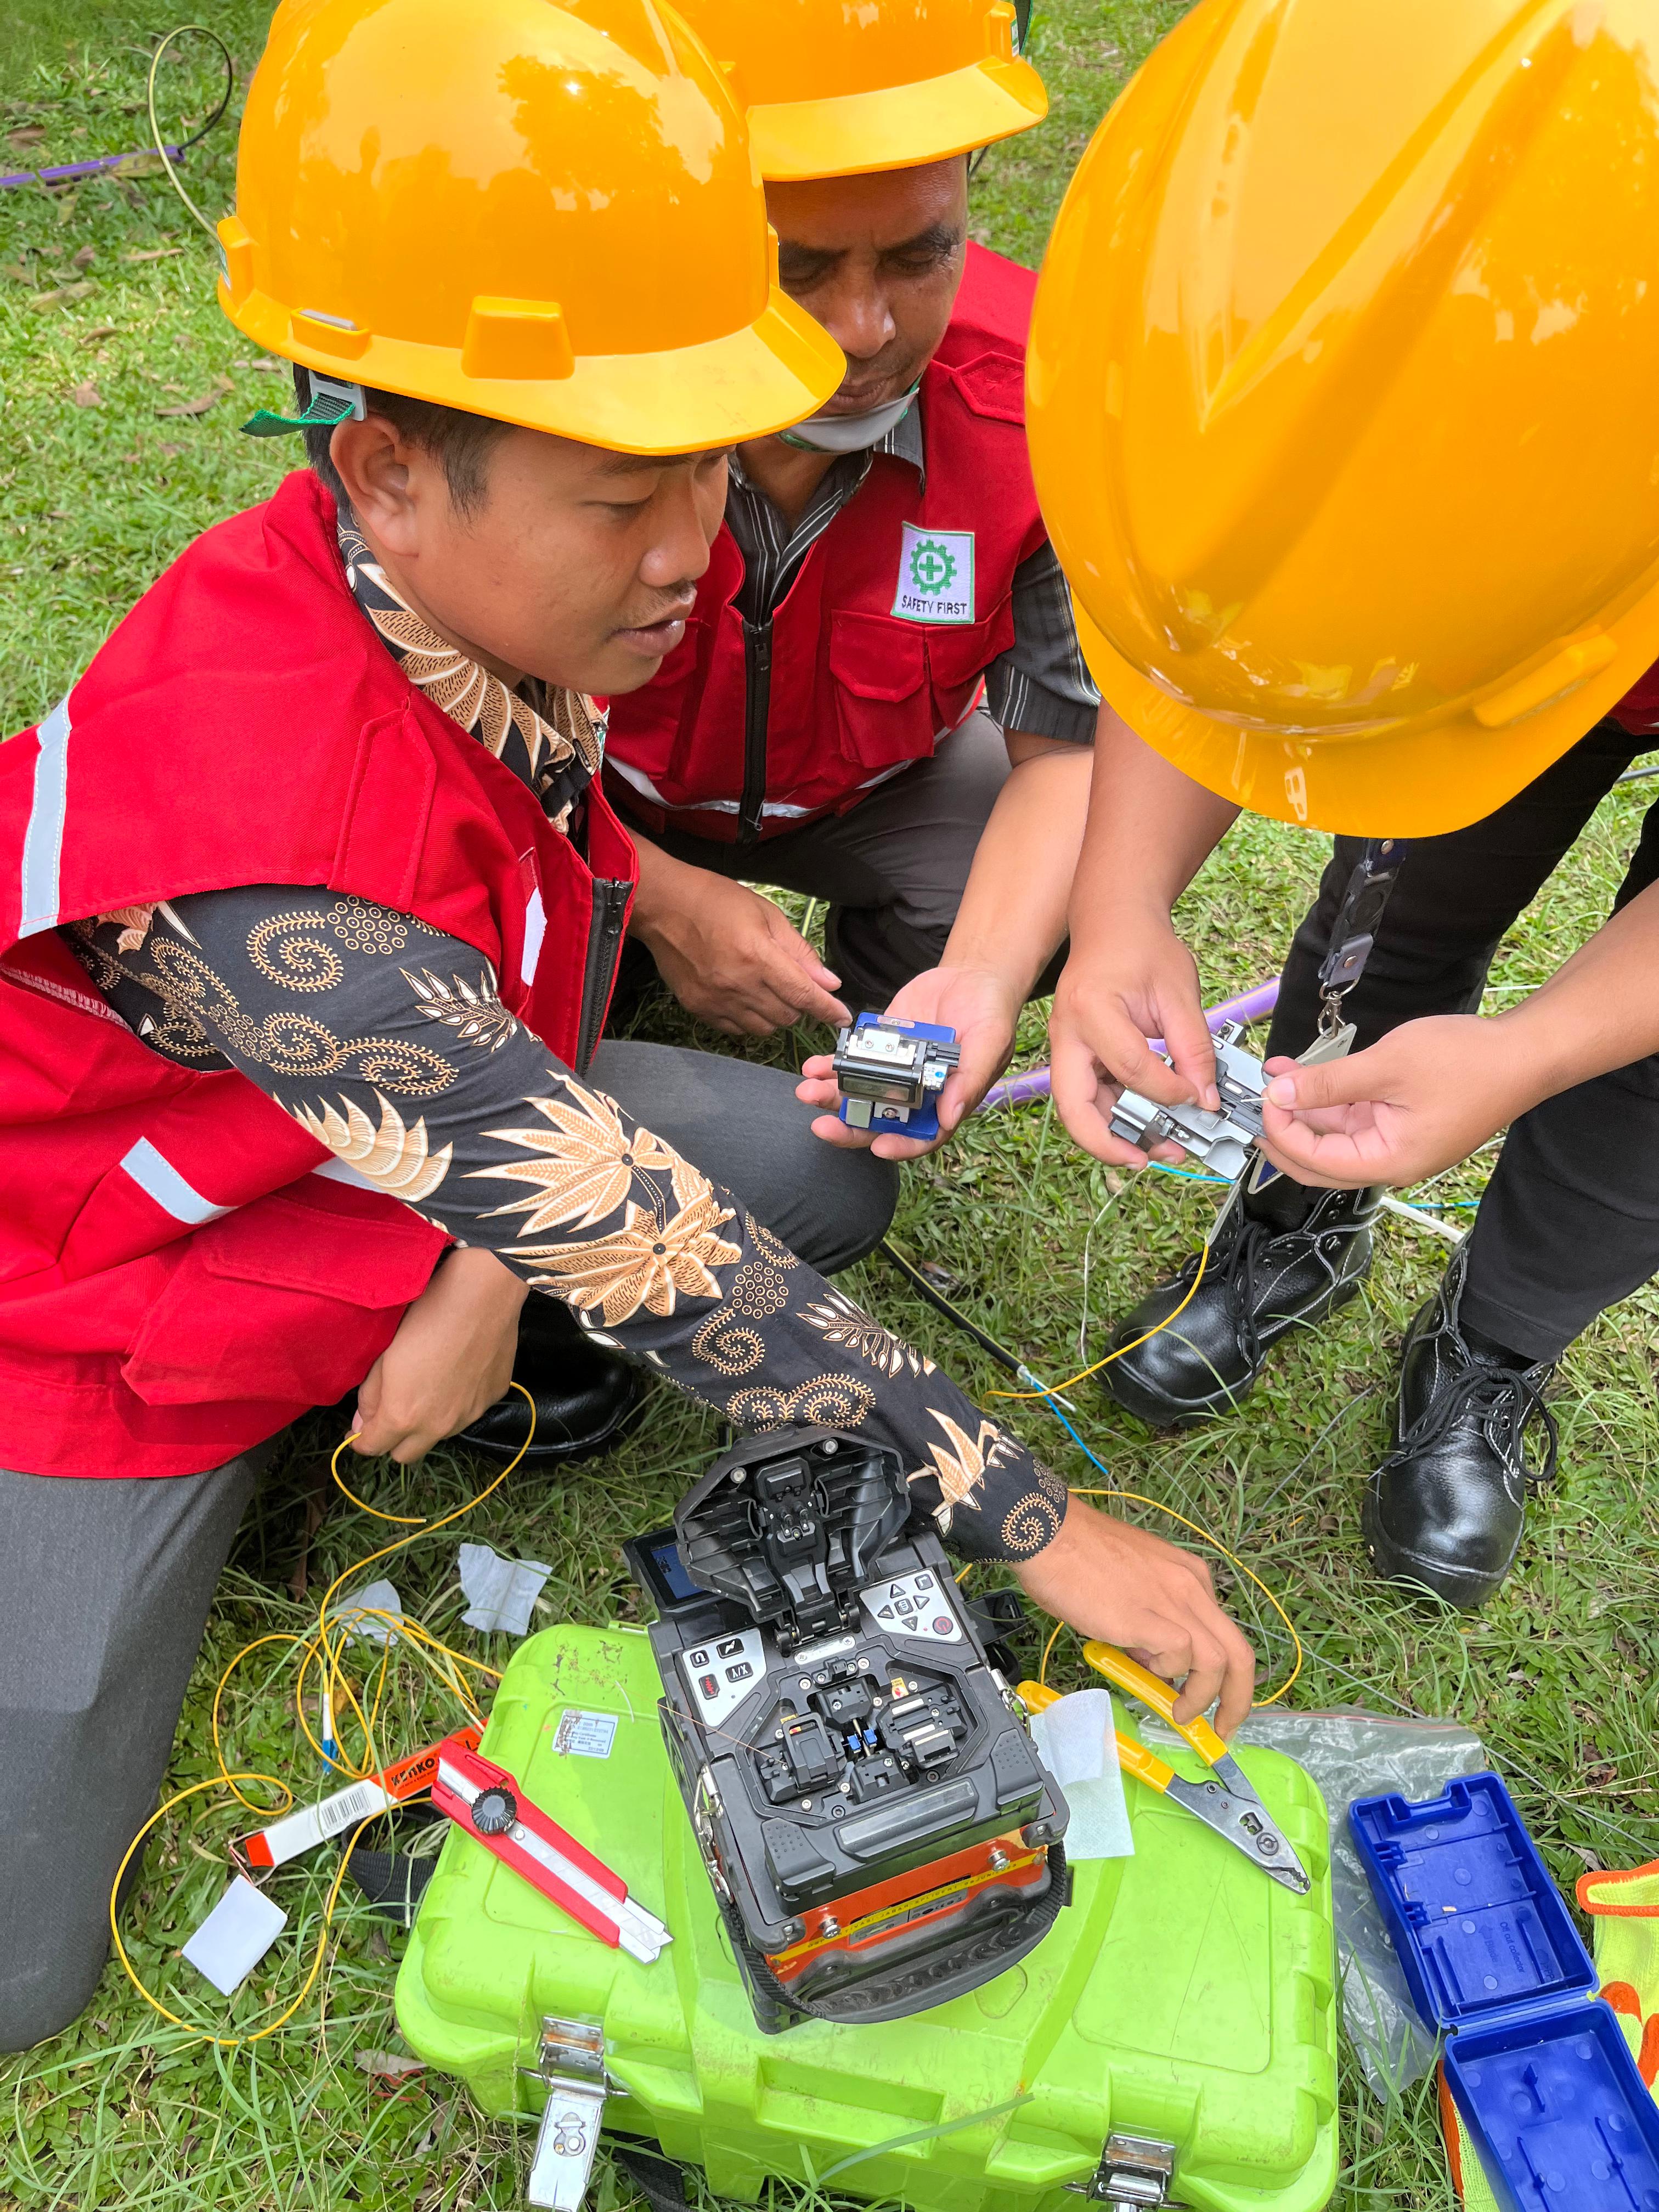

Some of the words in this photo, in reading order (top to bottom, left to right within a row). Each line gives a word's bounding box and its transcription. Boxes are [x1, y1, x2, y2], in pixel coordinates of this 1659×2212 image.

[901, 595, 934, 613] SAFETY
[937, 602, 967, 614] FIRST
[391, 1758, 435, 1786] KENKO
[1500, 1921, 1511, 1933] Off
[1504, 1933, 1515, 1945] cut
[1509, 1945, 1525, 1973] collector
